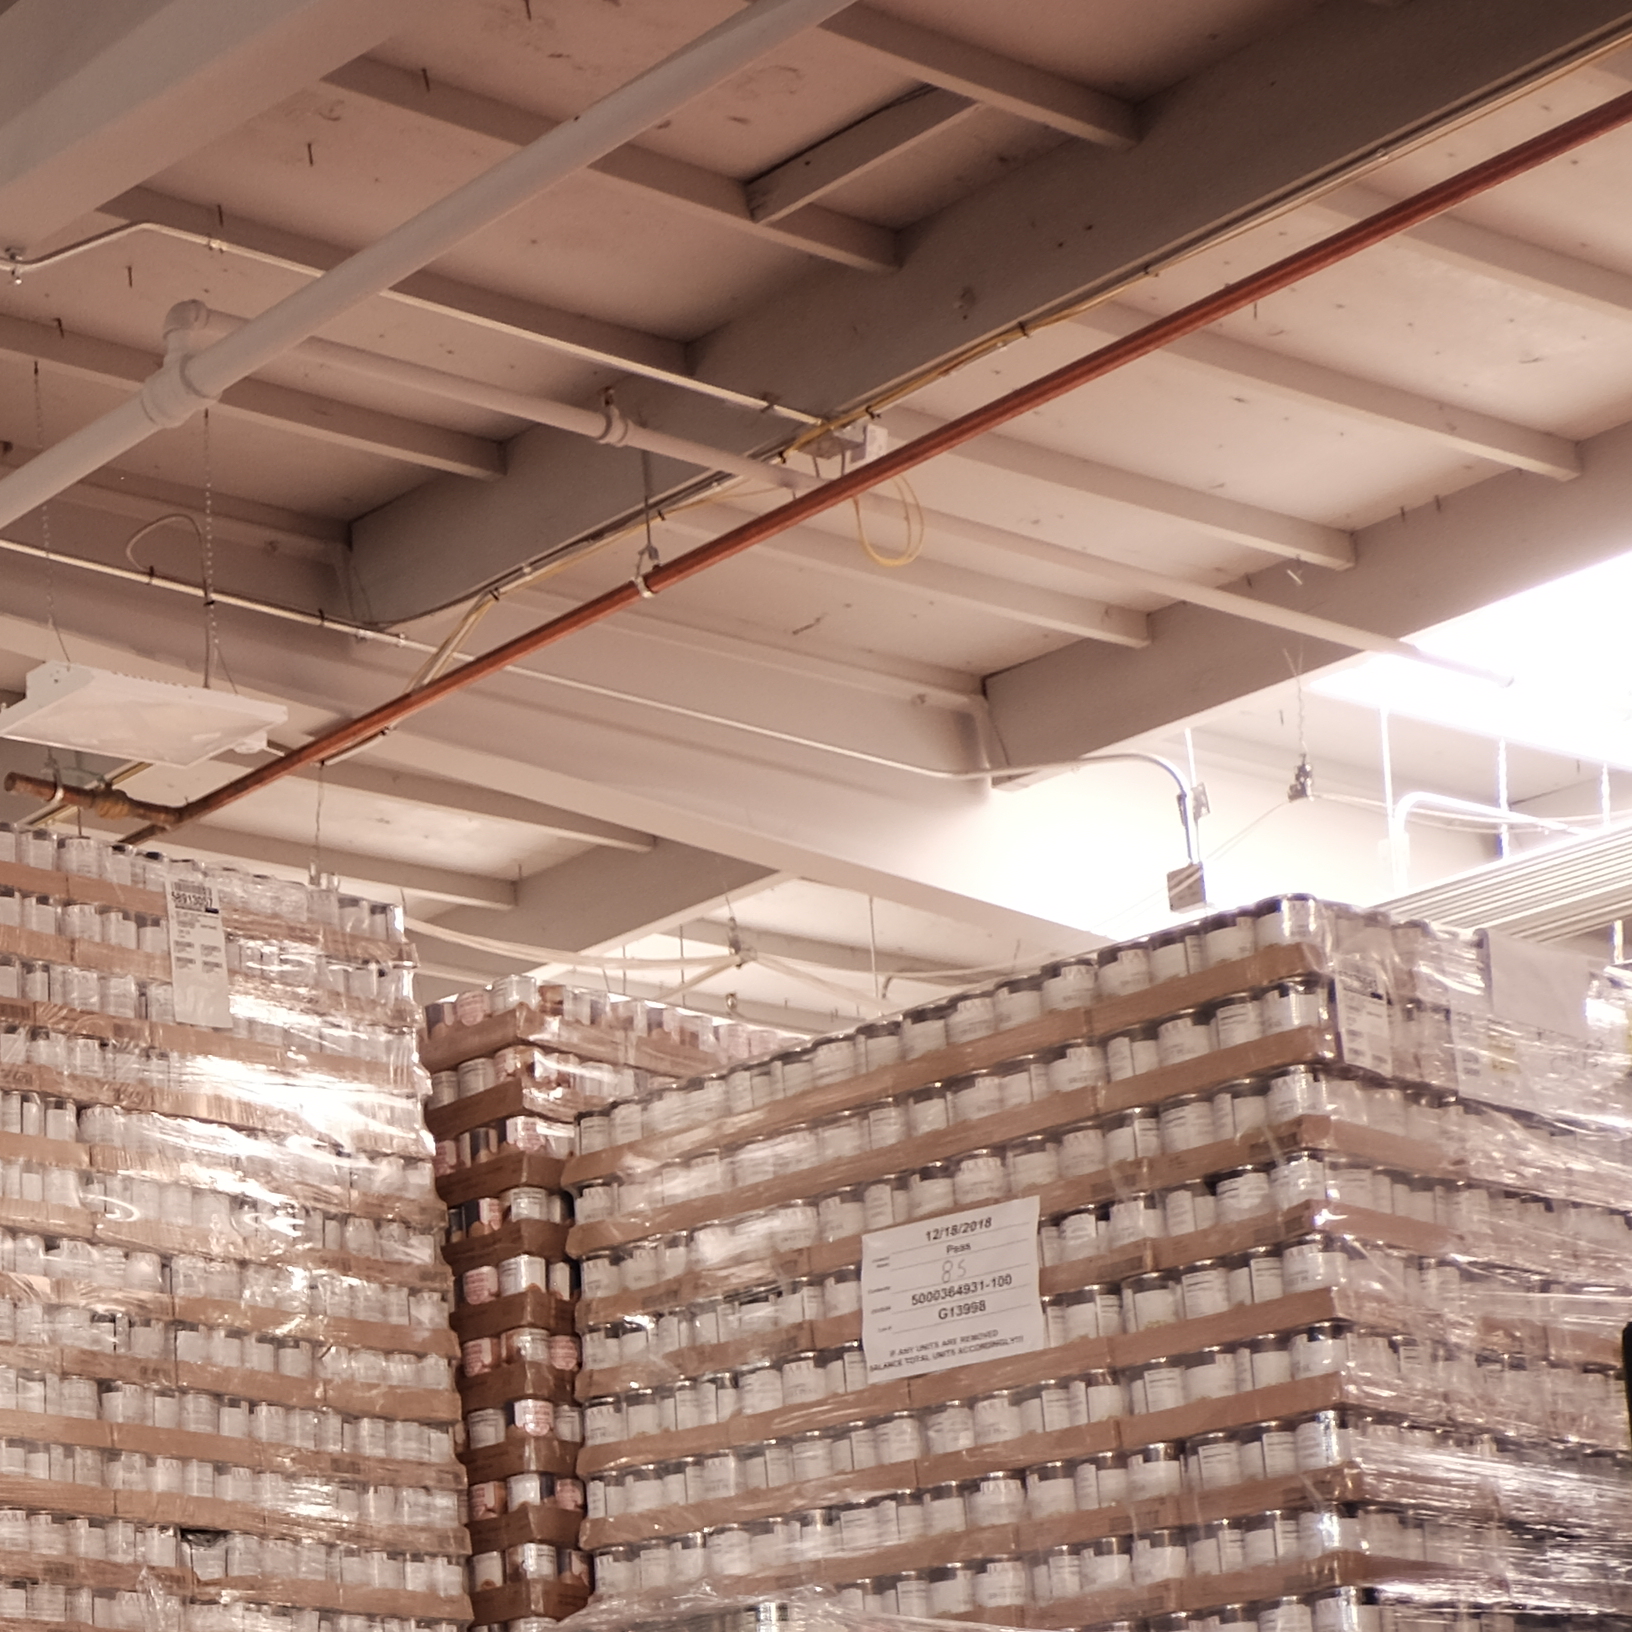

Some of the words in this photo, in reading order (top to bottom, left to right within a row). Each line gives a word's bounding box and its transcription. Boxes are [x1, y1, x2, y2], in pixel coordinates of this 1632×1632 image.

[925, 1217, 992, 1241] 12/18/2018
[946, 1243, 971, 1254] Peas
[916, 1342, 940, 1353] UNITS
